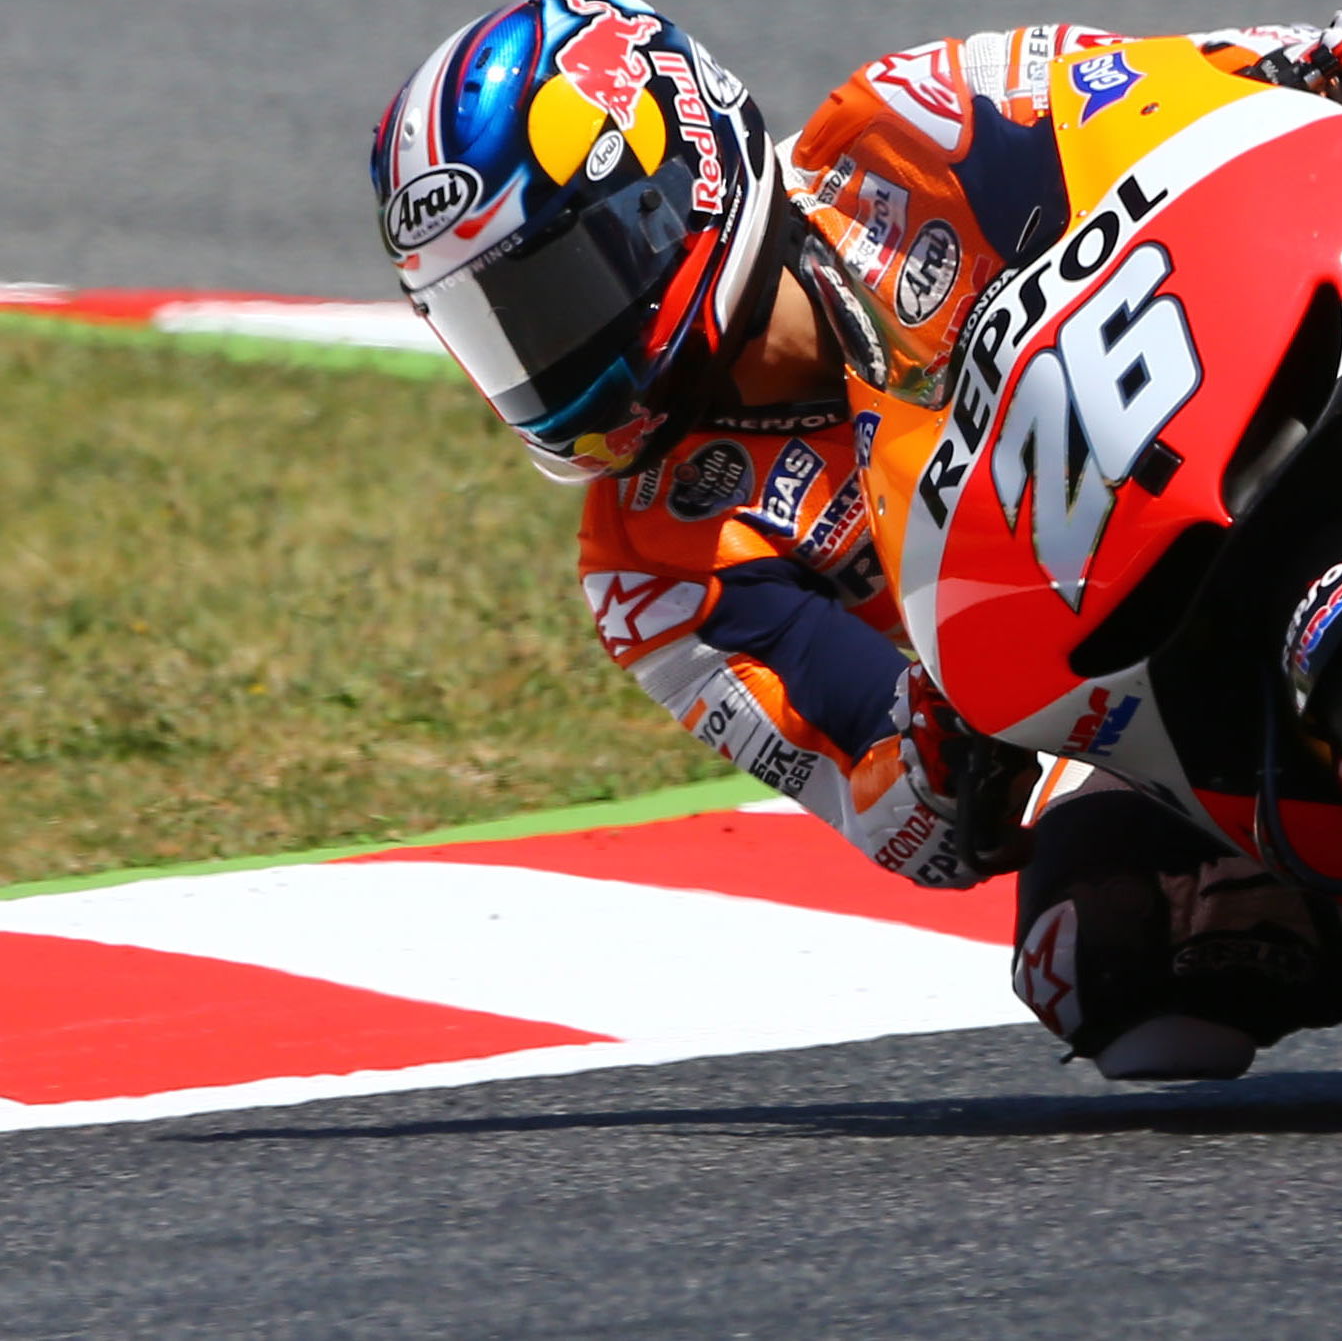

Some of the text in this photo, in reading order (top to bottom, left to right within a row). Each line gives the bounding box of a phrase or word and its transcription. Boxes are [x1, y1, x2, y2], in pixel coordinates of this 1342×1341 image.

[649, 51, 711, 128] Bull
[1079, 55, 1129, 91] GAS
[395, 171, 463, 243] Arai
[680, 125, 723, 214] Red
[470, 232, 525, 274] WINGS
[905, 235, 949, 319] Arai
[919, 175, 1168, 530] REPSOL
[992, 240, 1204, 610] 26
[767, 447, 816, 528] GAS
[875, 803, 940, 872] HONDA
